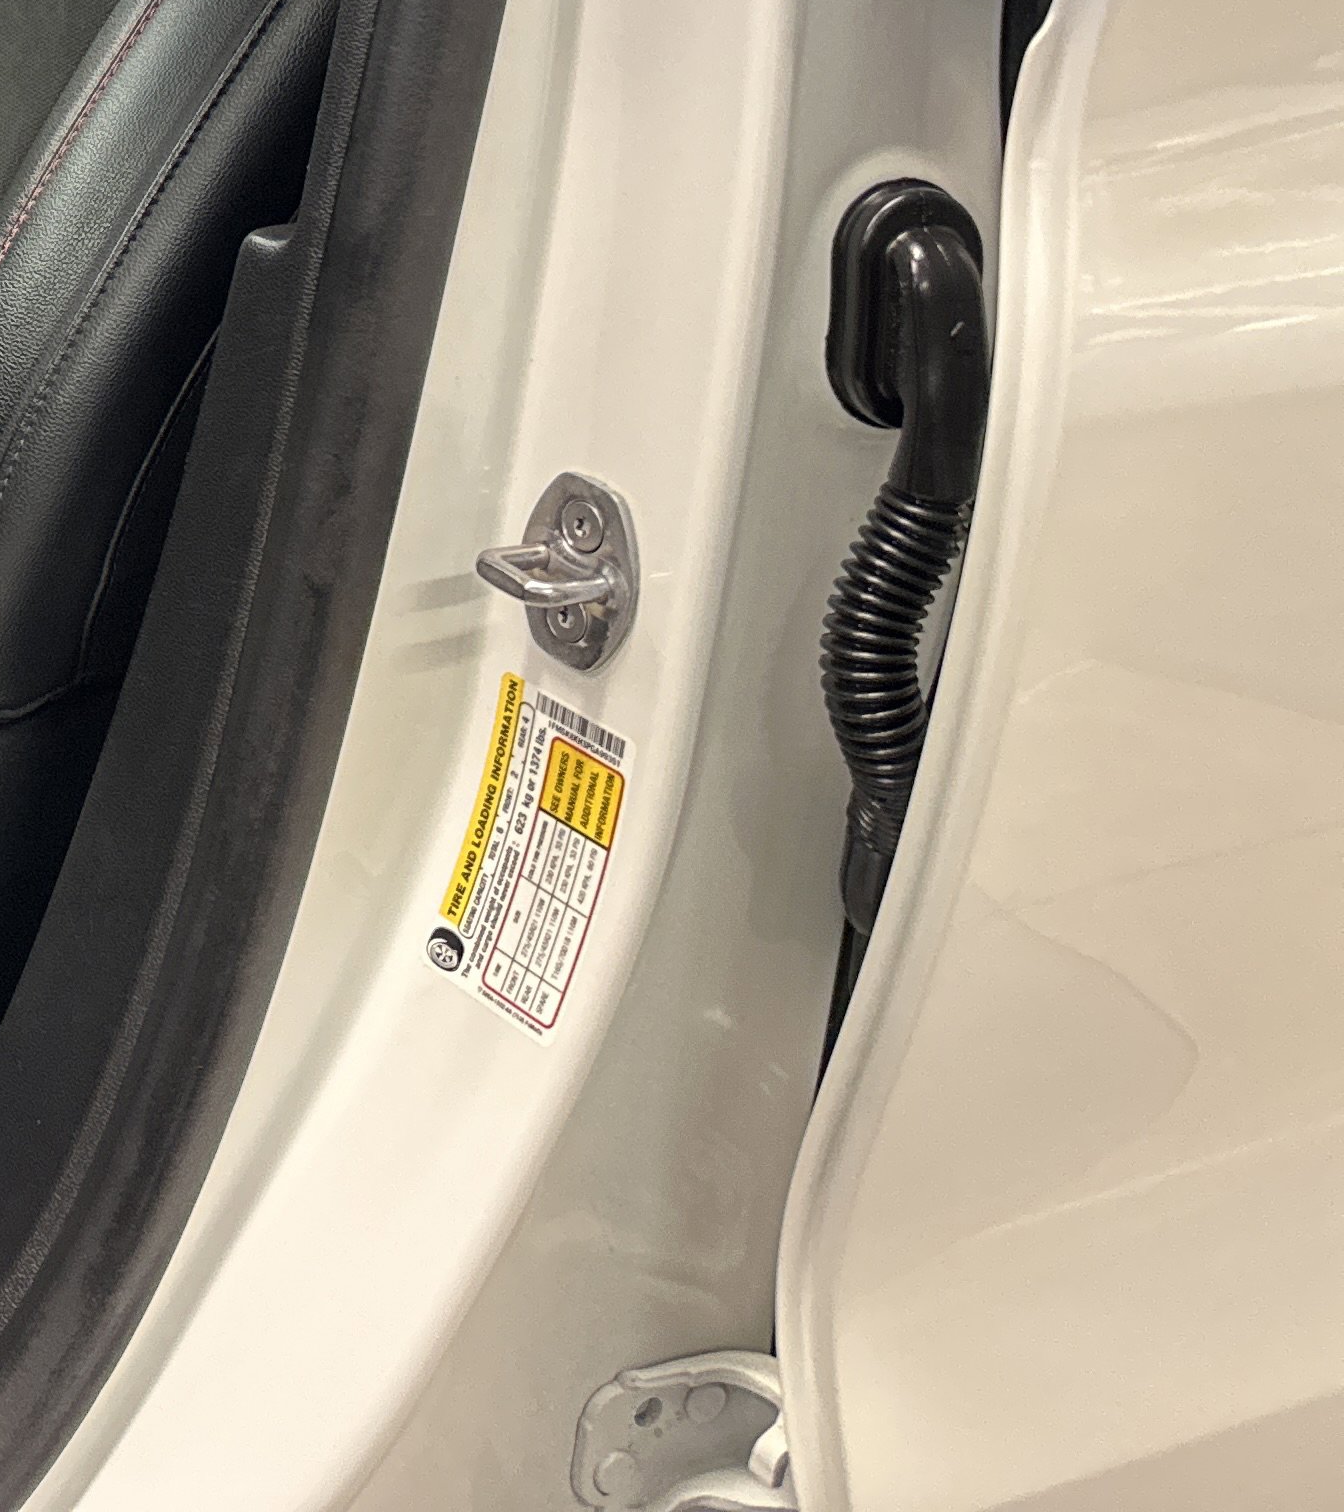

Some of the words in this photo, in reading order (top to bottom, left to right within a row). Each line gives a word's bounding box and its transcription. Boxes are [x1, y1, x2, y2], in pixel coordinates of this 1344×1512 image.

[529, 746, 543, 775] 1374
[554, 751, 570, 793] OWNERS
[447, 883, 466, 916] TIRE
[461, 850, 477, 883] AND
[471, 784, 497, 848] LOADING
[490, 679, 518, 781] INFORMATION
[521, 793, 534, 808] kg
[527, 777, 535, 791] or
[564, 782, 580, 823] MANUAL
[573, 758, 584, 780] FOR
[580, 771, 599, 829] ADDITIONAL
[549, 794, 561, 813] SEE
[594, 772, 615, 840] INFORMATION
[514, 811, 527, 835] 623
